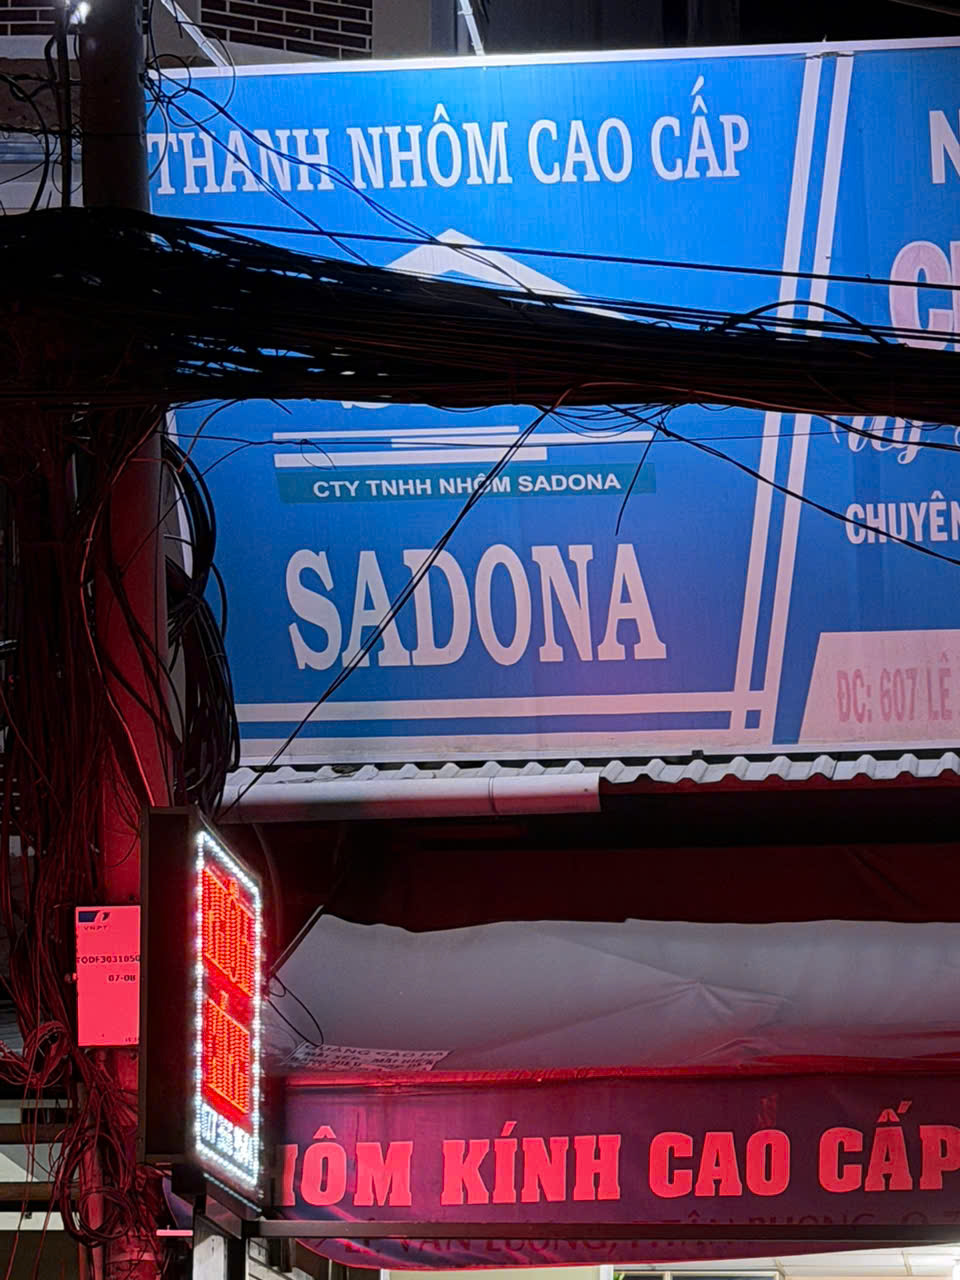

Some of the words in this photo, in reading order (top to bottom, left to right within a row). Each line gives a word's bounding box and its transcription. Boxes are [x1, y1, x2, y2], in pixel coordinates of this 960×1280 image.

[146, 128, 335, 195] THANH
[348, 103, 512, 190] NHÔM
[528, 118, 633, 185] CAO
[651, 75, 749, 180] CẤP
[312, 480, 359, 499] CTY
[366, 478, 432, 497] TNHH
[439, 473, 511, 495] NHÔM
[518, 472, 621, 493] SADONA
[285, 542, 667, 671] SADONA
[837, 668, 872, 723] ĐC:
[879, 667, 918, 722] 607
[926, 652, 952, 721] LÊ
[441, 1120, 622, 1206] KÍNH
[649, 1129, 791, 1199] CAO
